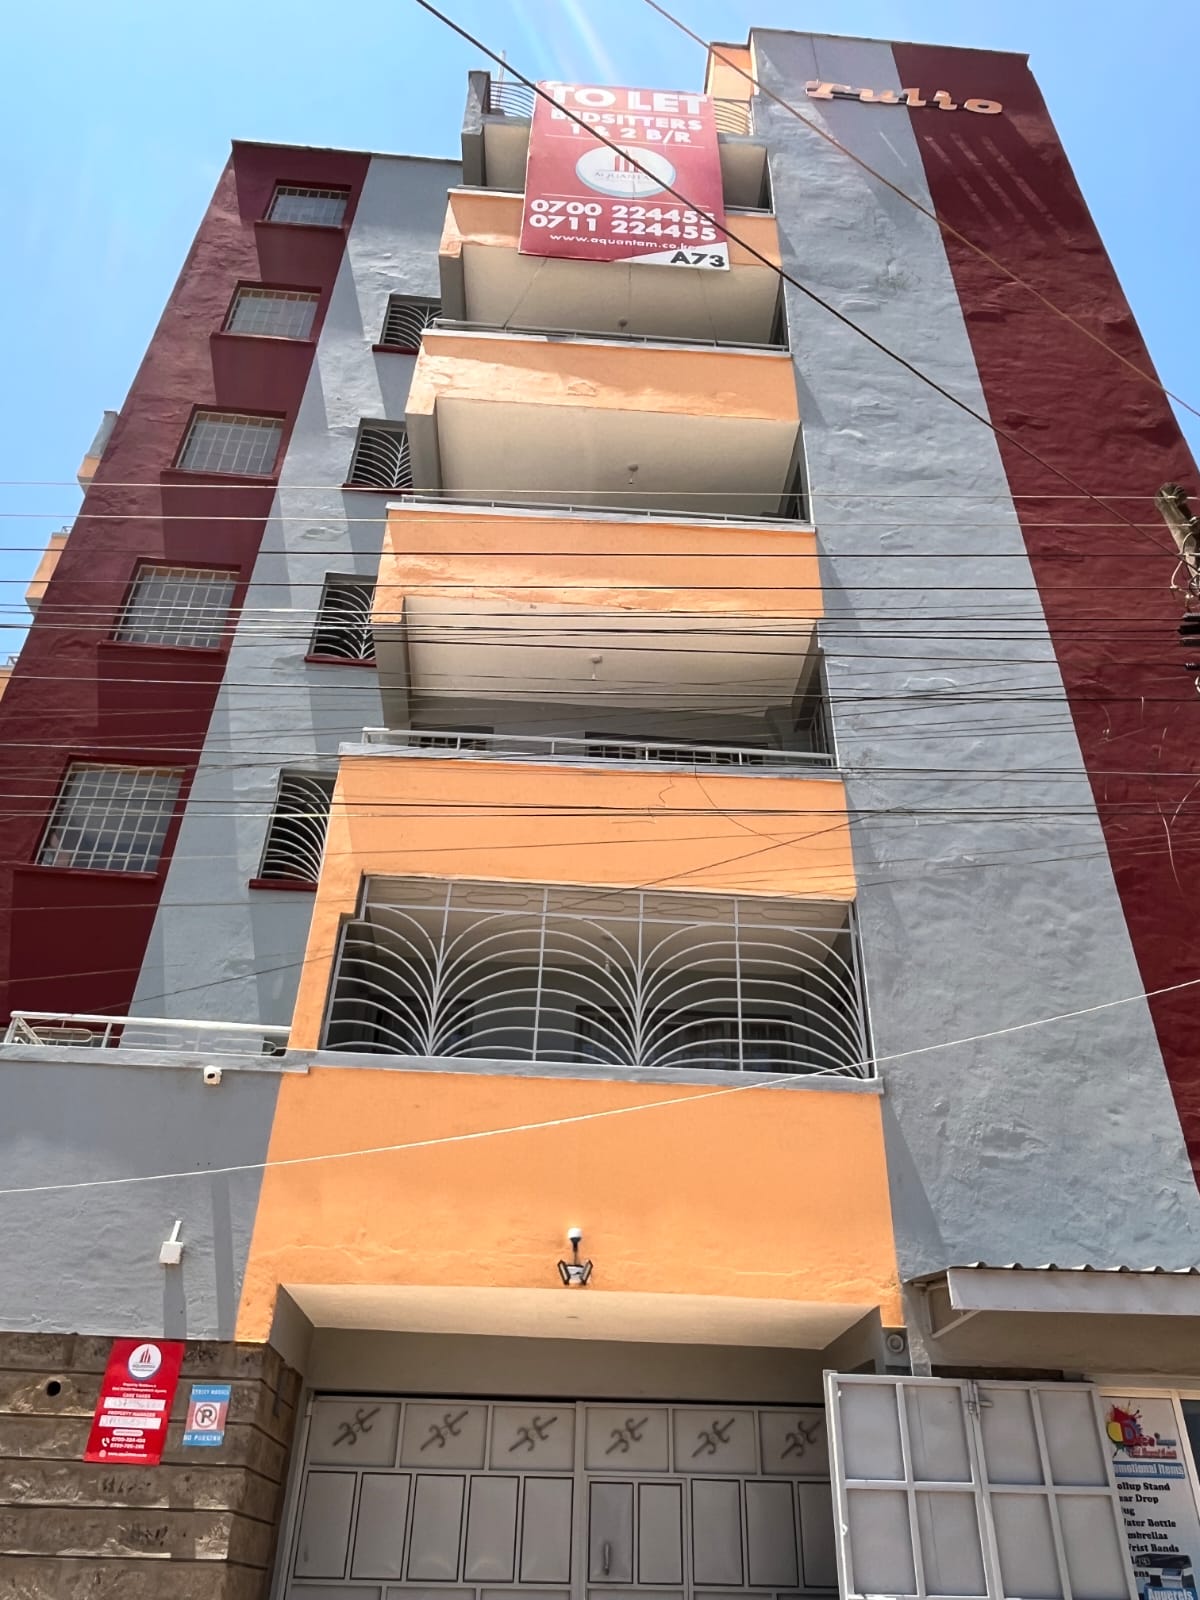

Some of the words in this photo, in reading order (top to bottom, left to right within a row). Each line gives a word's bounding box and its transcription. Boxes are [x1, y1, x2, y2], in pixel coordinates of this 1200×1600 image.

[546, 83, 617, 108] TO
[628, 91, 707, 115] LET
[572, 123, 580, 134] 1
[621, 128, 637, 139] 2
[646, 130, 692, 144] B/R
[530, 199, 602, 217] 0700
[611, 205, 715, 225] 224455
[529, 213, 597, 231] 0711
[610, 220, 717, 241] 224455
[670, 251, 725, 268] A73
[1158, 1463, 1185, 1475] Items
[1117, 1482, 1141, 1491] ollup
[1143, 1482, 1170, 1491] Stand
[1136, 1494, 1159, 1504] Drop
[1121, 1508, 1136, 1516] ug
[1124, 1518, 1145, 1527] ater
[1147, 1519, 1176, 1528] Bottle
[1128, 1531, 1168, 1540] mbrellas
[1151, 1544, 1179, 1553] Bands
